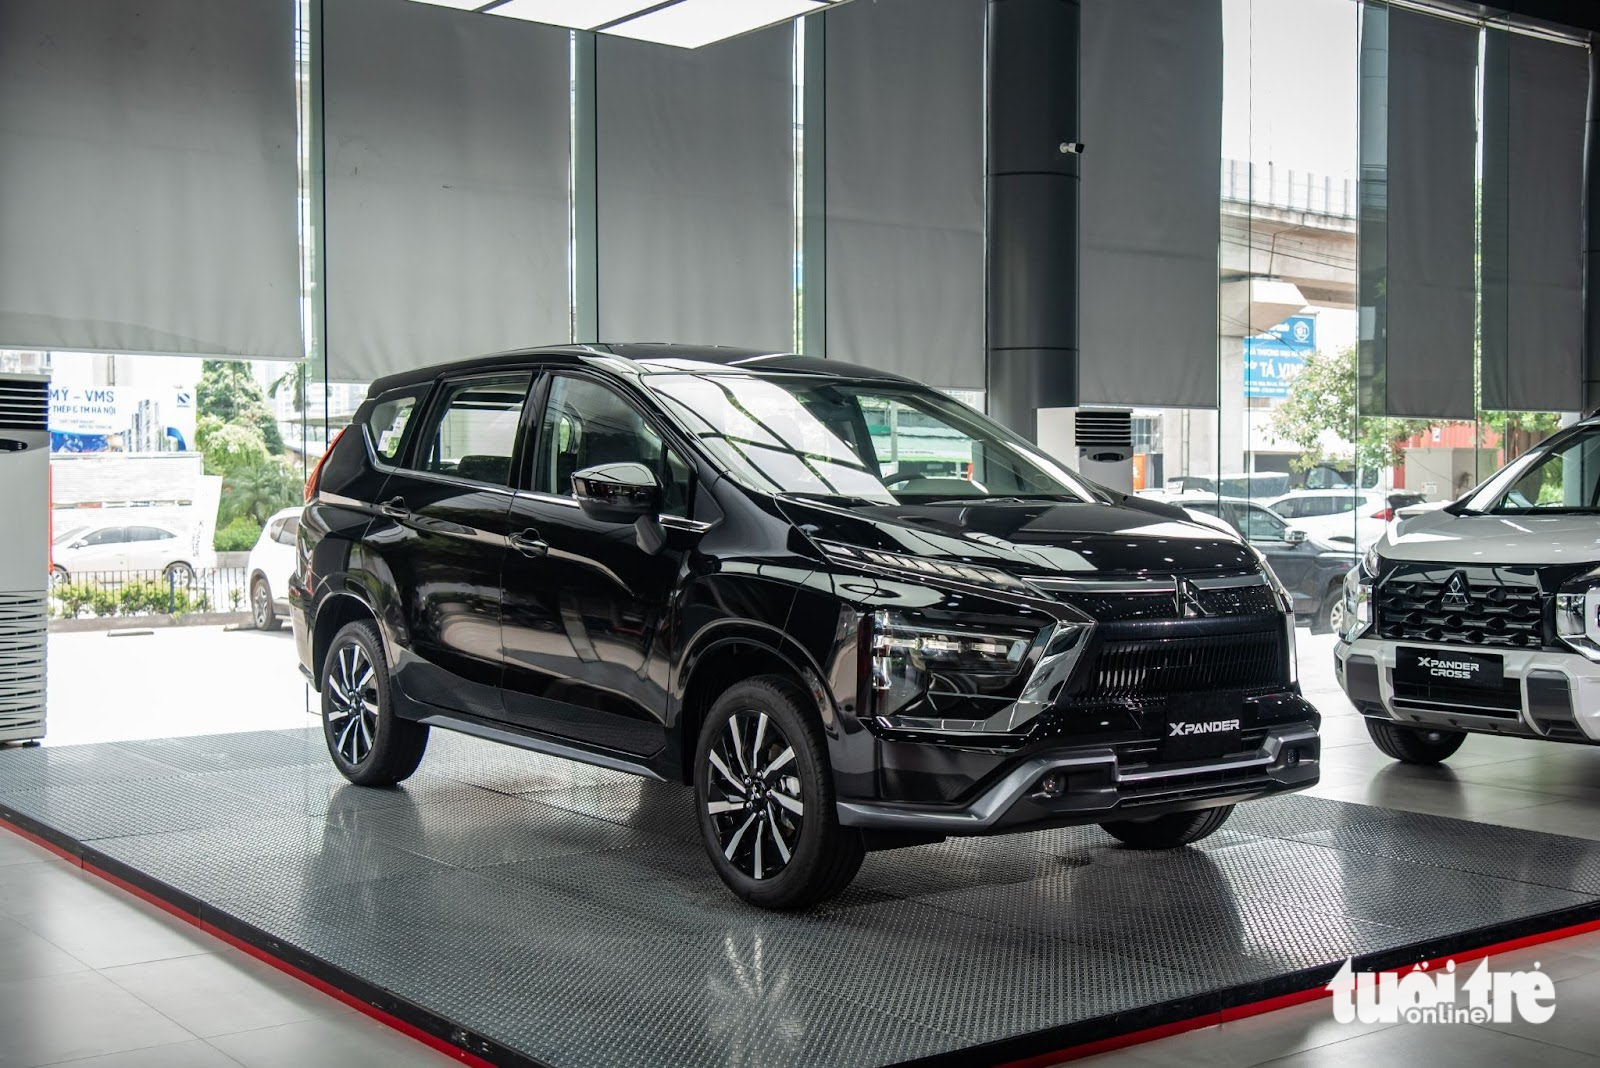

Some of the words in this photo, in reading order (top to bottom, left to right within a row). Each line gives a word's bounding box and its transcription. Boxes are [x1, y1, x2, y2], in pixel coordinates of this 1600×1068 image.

[85, 389, 114, 403] VMS
[1418, 656, 1480, 671] XPANDER
[1430, 668, 1471, 679] CROSS
[1168, 719, 1240, 737] XPANDER
